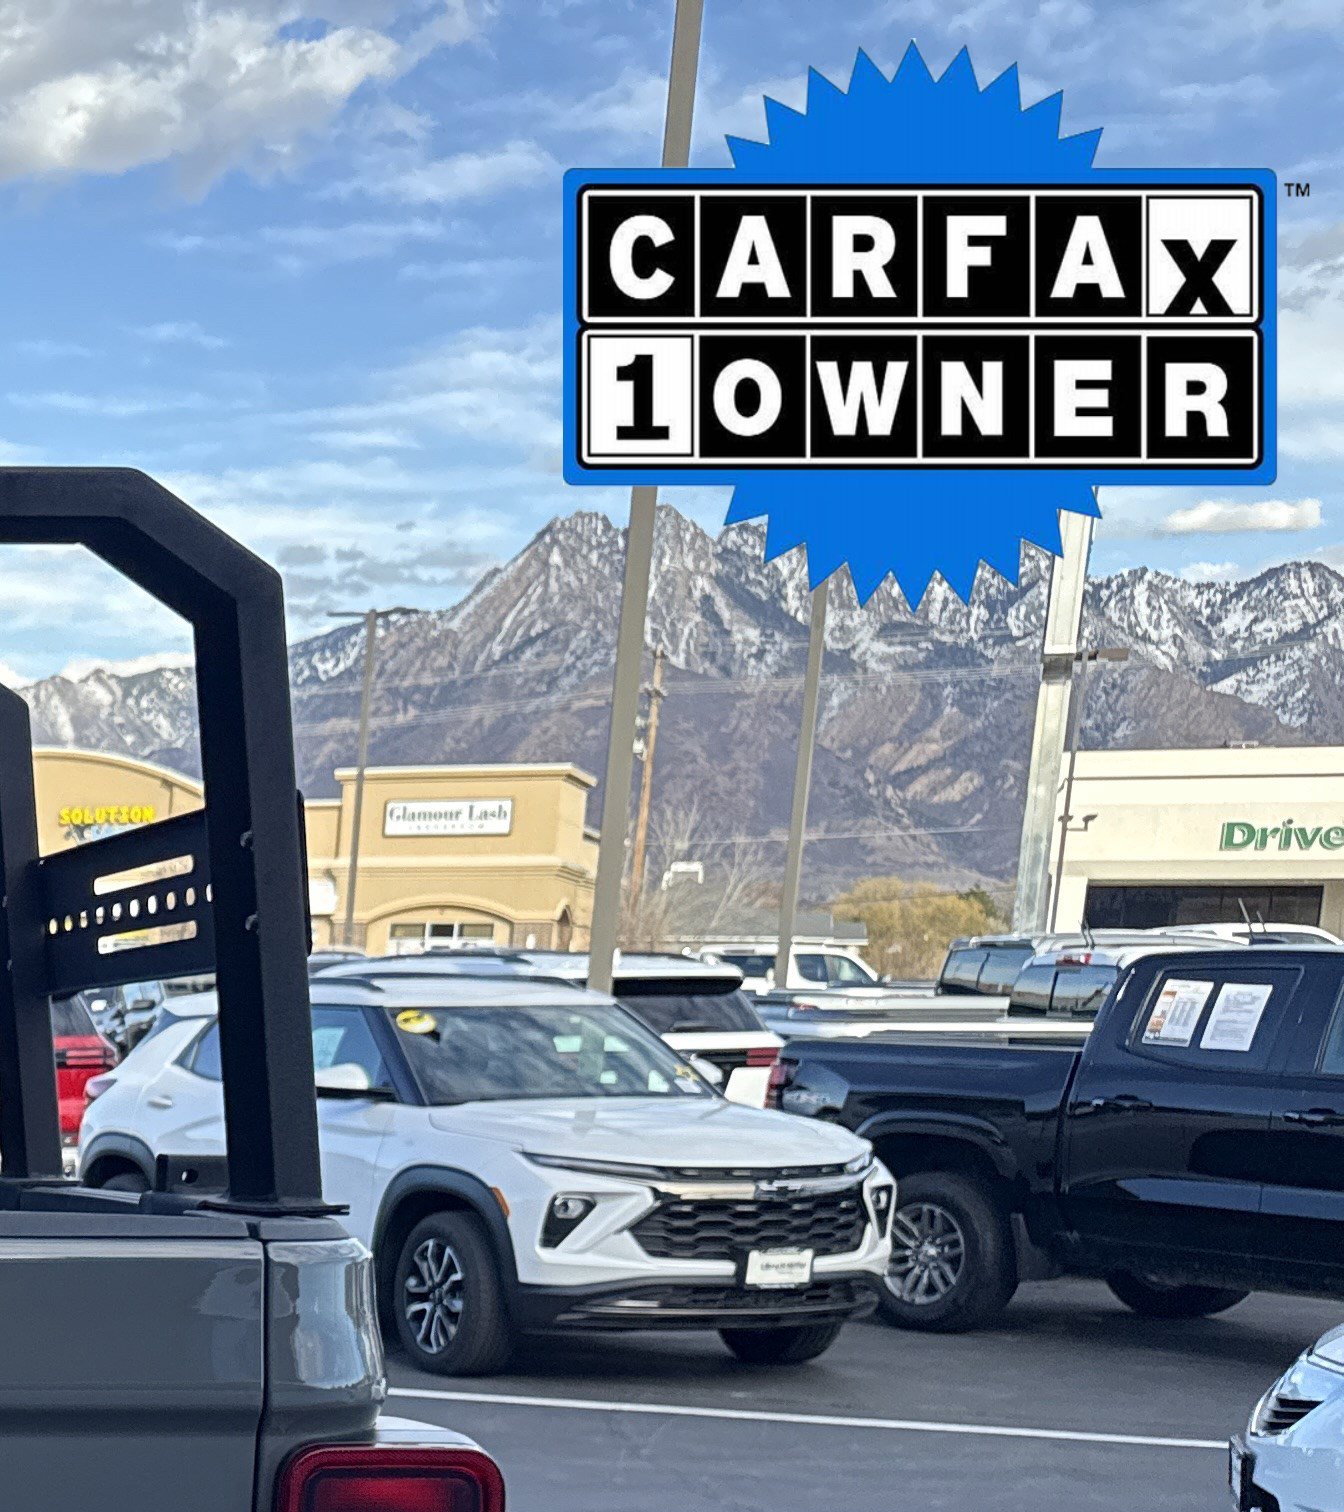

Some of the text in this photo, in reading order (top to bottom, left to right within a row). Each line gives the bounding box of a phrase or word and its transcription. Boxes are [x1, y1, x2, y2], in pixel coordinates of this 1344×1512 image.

[58, 804, 156, 826] SOLUTION
[389, 804, 508, 821] Glamour Lash
